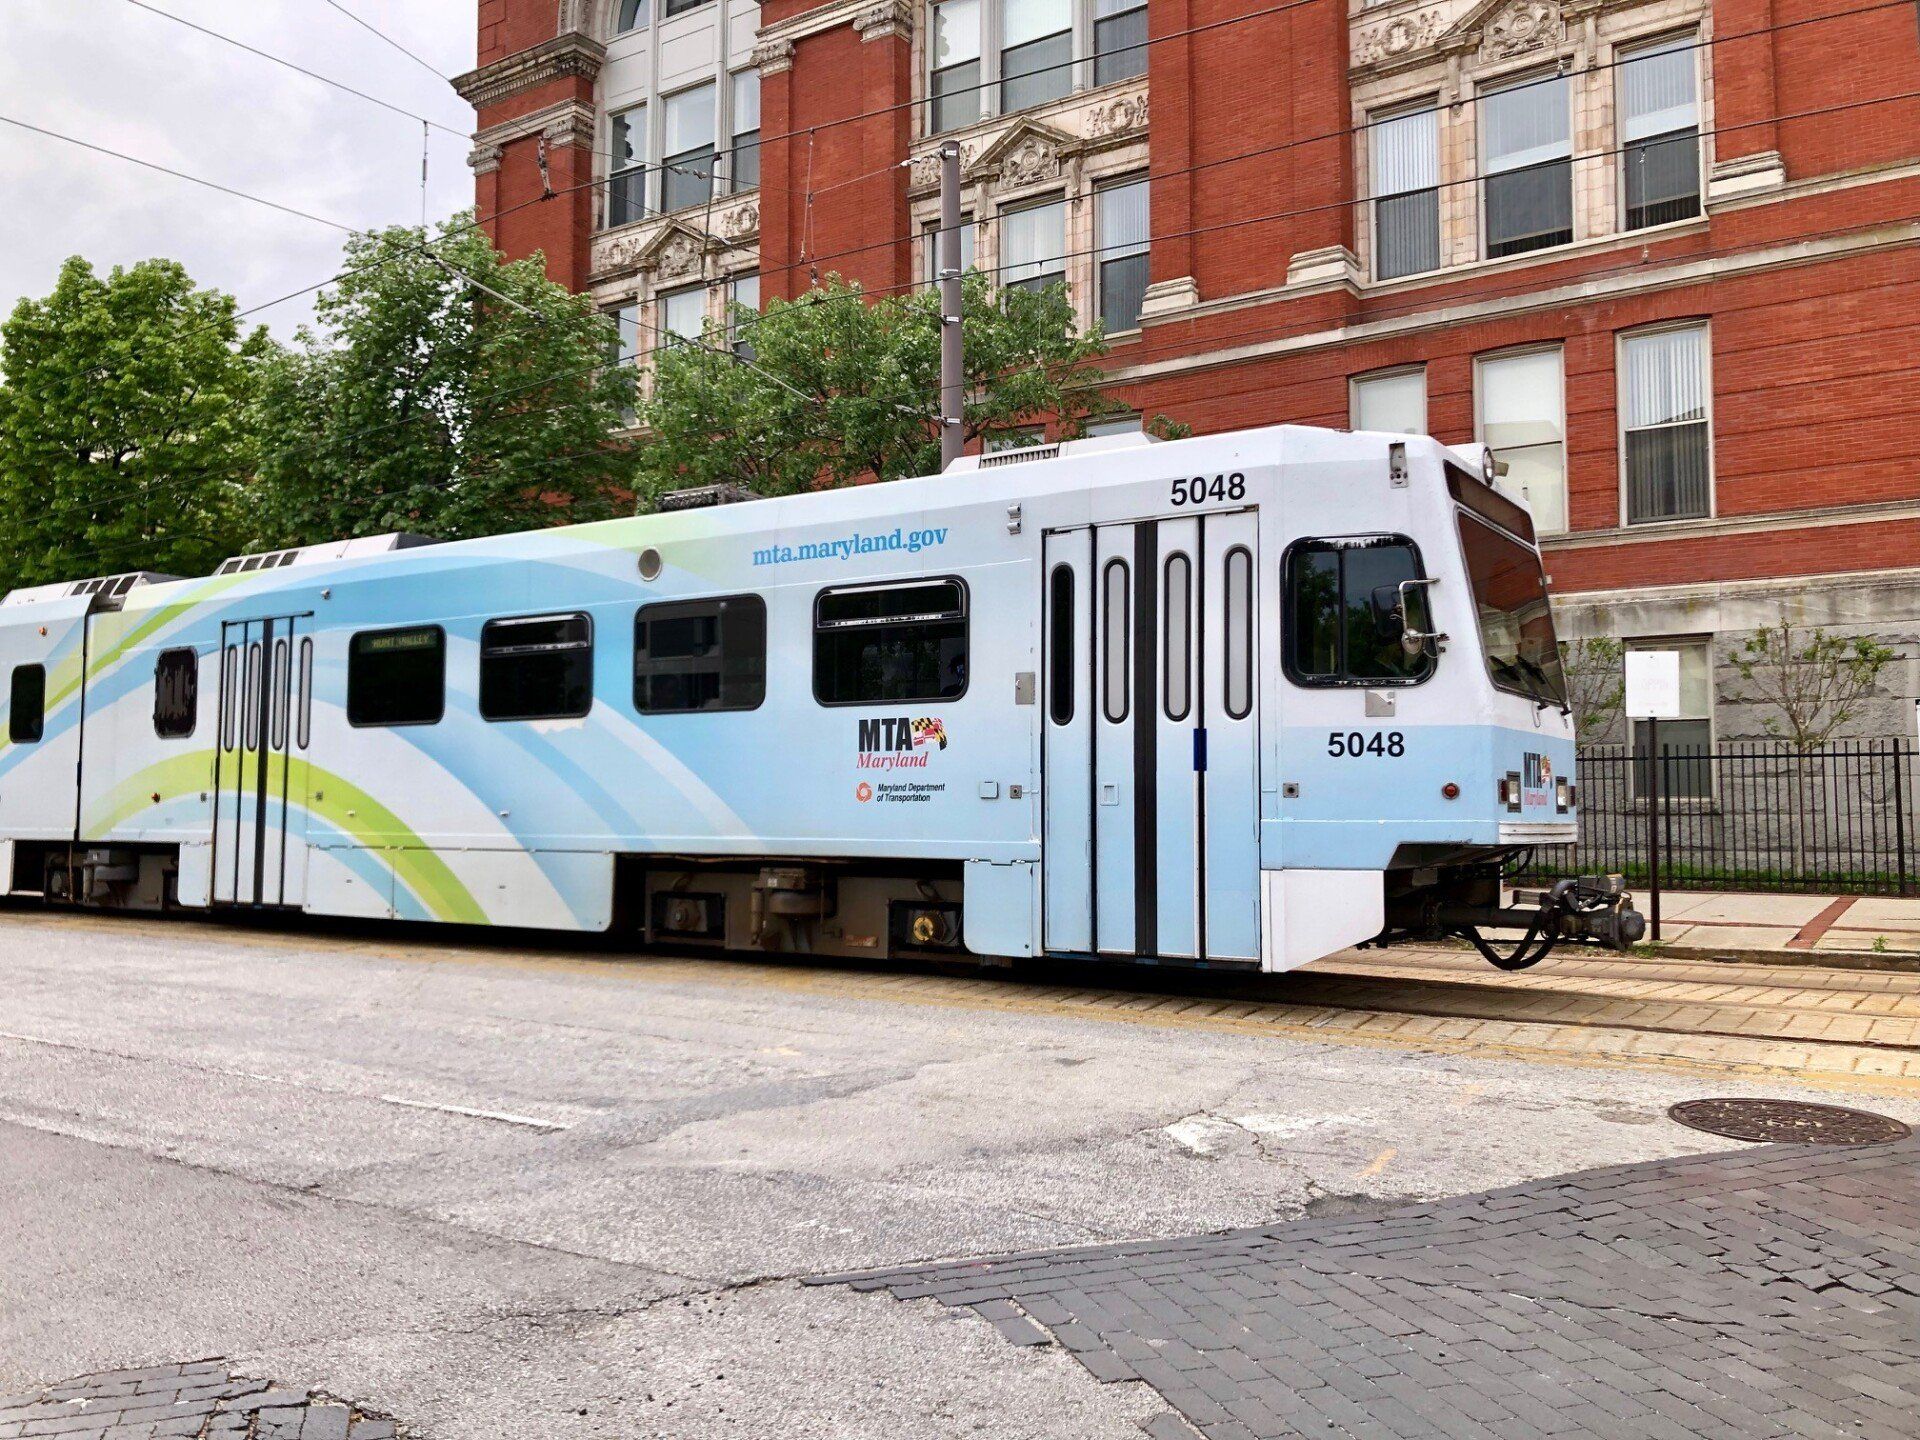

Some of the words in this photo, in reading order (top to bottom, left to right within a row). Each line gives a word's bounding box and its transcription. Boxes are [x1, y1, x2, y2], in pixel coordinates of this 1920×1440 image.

[1170, 472, 1246, 507] 5048
[752, 528, 949, 566] mta.maryland.gov
[858, 717, 913, 752] MTA
[1327, 731, 1405, 758] 5048
[856, 751, 929, 772] Maryland
[876, 793, 884, 803] of
[885, 793, 931, 803] Transportation
[877, 783, 907, 794] Maryland
[908, 782, 946, 793] Department
